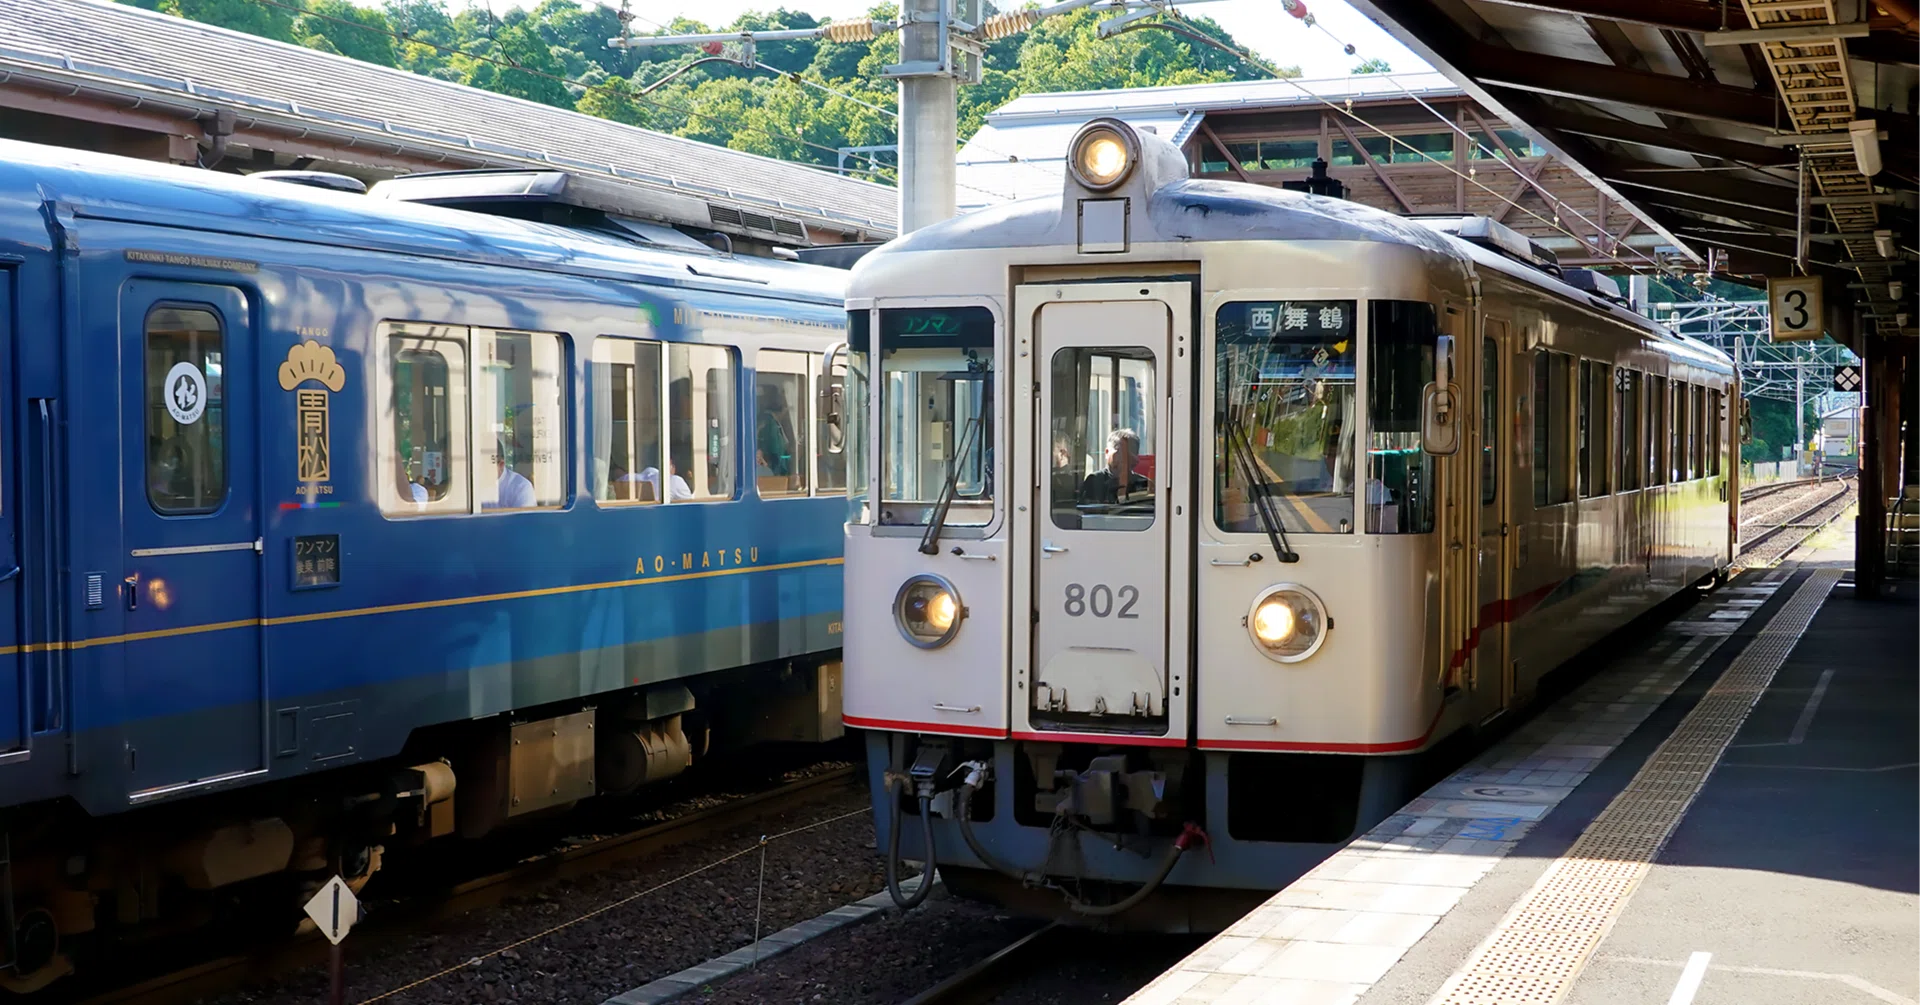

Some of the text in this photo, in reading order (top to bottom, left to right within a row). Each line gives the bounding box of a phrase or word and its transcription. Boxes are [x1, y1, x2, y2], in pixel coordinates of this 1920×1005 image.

[127, 251, 257, 272] KITAKINKI TANGO RAILWAY COMPANY
[1251, 306, 1343, 330] 西舞鶴
[1784, 289, 1809, 330] 3
[296, 326, 328, 337] TANGO
[299, 391, 329, 480] 青松
[296, 540, 335, 556] ワンマン
[1064, 583, 1140, 619] 802
[827, 621, 844, 635] KITA
